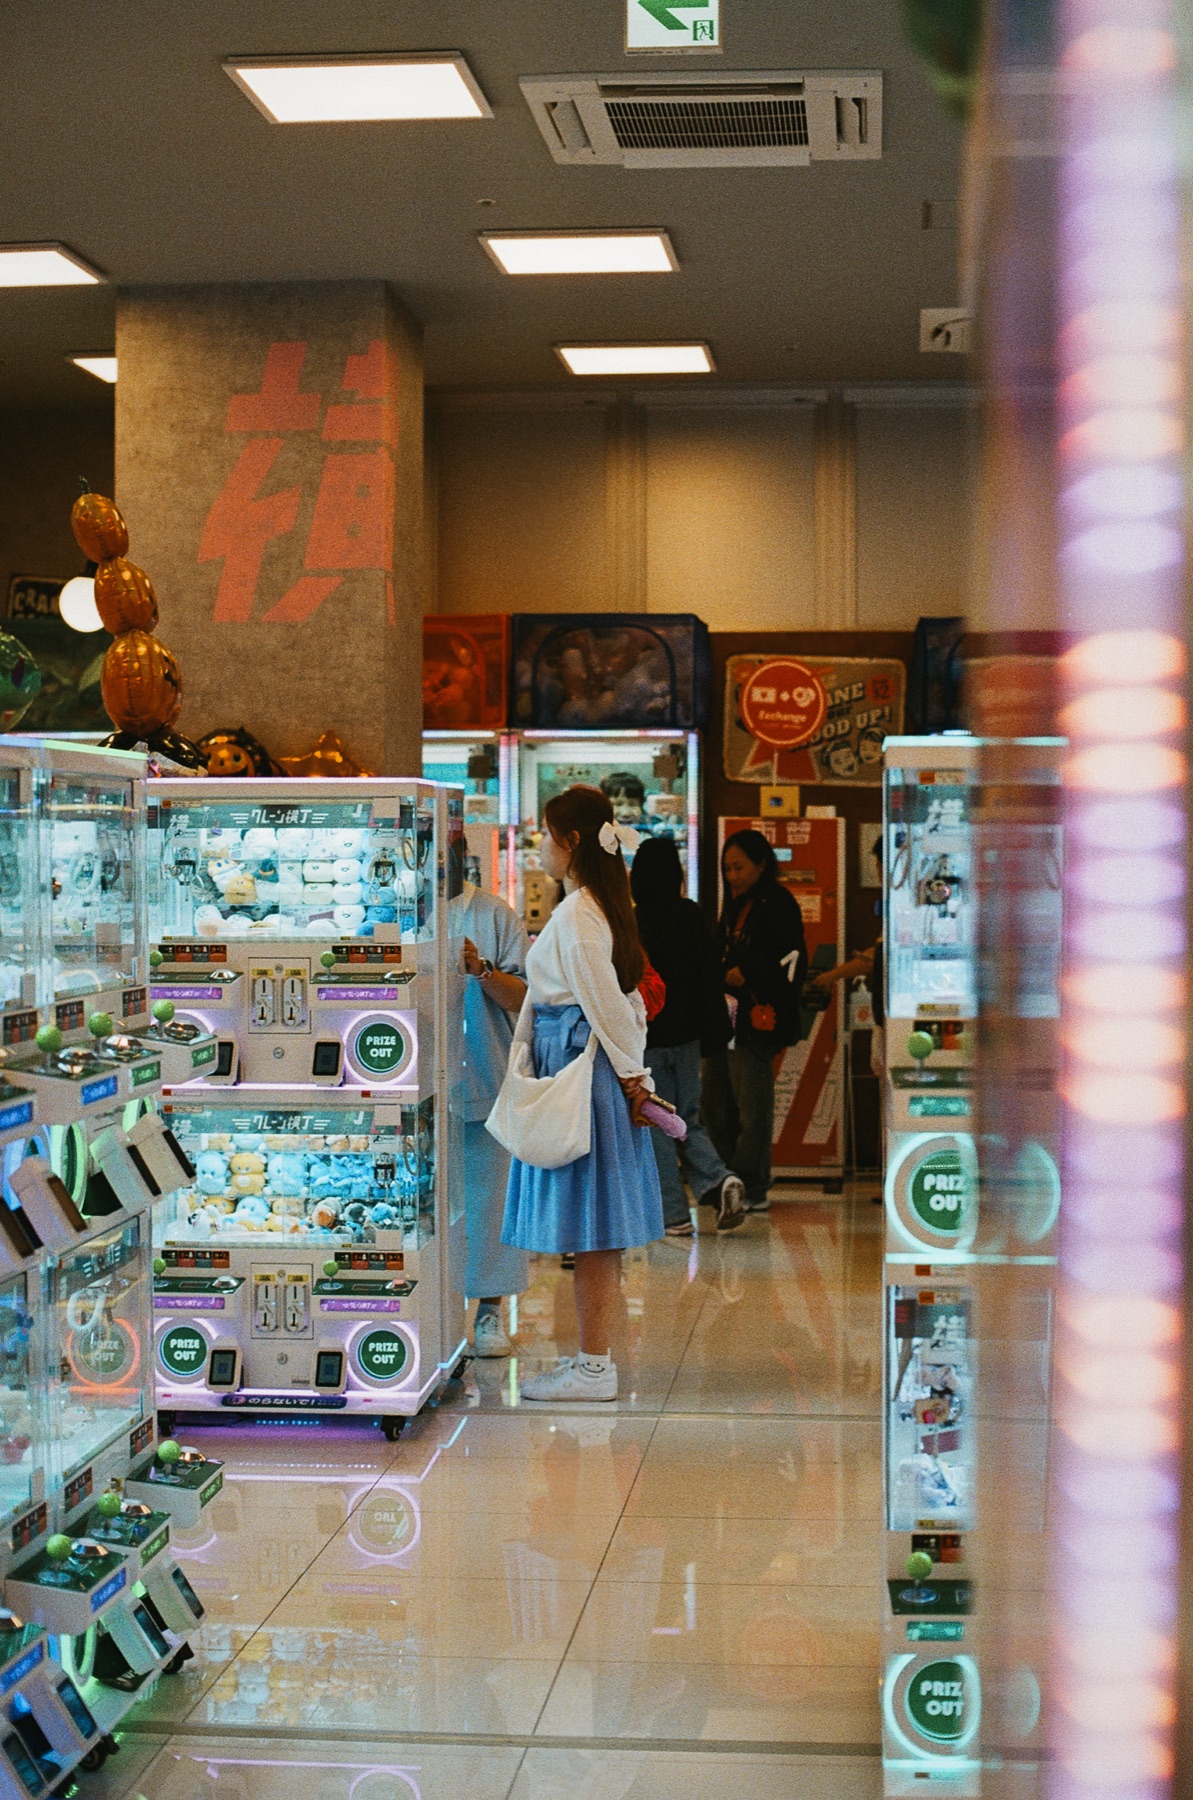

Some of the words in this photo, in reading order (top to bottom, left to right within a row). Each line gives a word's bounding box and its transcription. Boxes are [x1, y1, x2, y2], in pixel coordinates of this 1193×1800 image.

[251, 808, 313, 824] クレーン横丁
[366, 1035, 397, 1045] PRIZE
[370, 1048, 393, 1057] OUT
[253, 1115, 315, 1130] クレーン横丁
[923, 1173, 965, 1191] PRIZ
[170, 1339, 200, 1349] PRIZE
[369, 1342, 399, 1352] PRIZE
[173, 1350, 197, 1361] OUT
[372, 1354, 395, 1364] OUT
[920, 1680, 962, 1696] PRIZ
